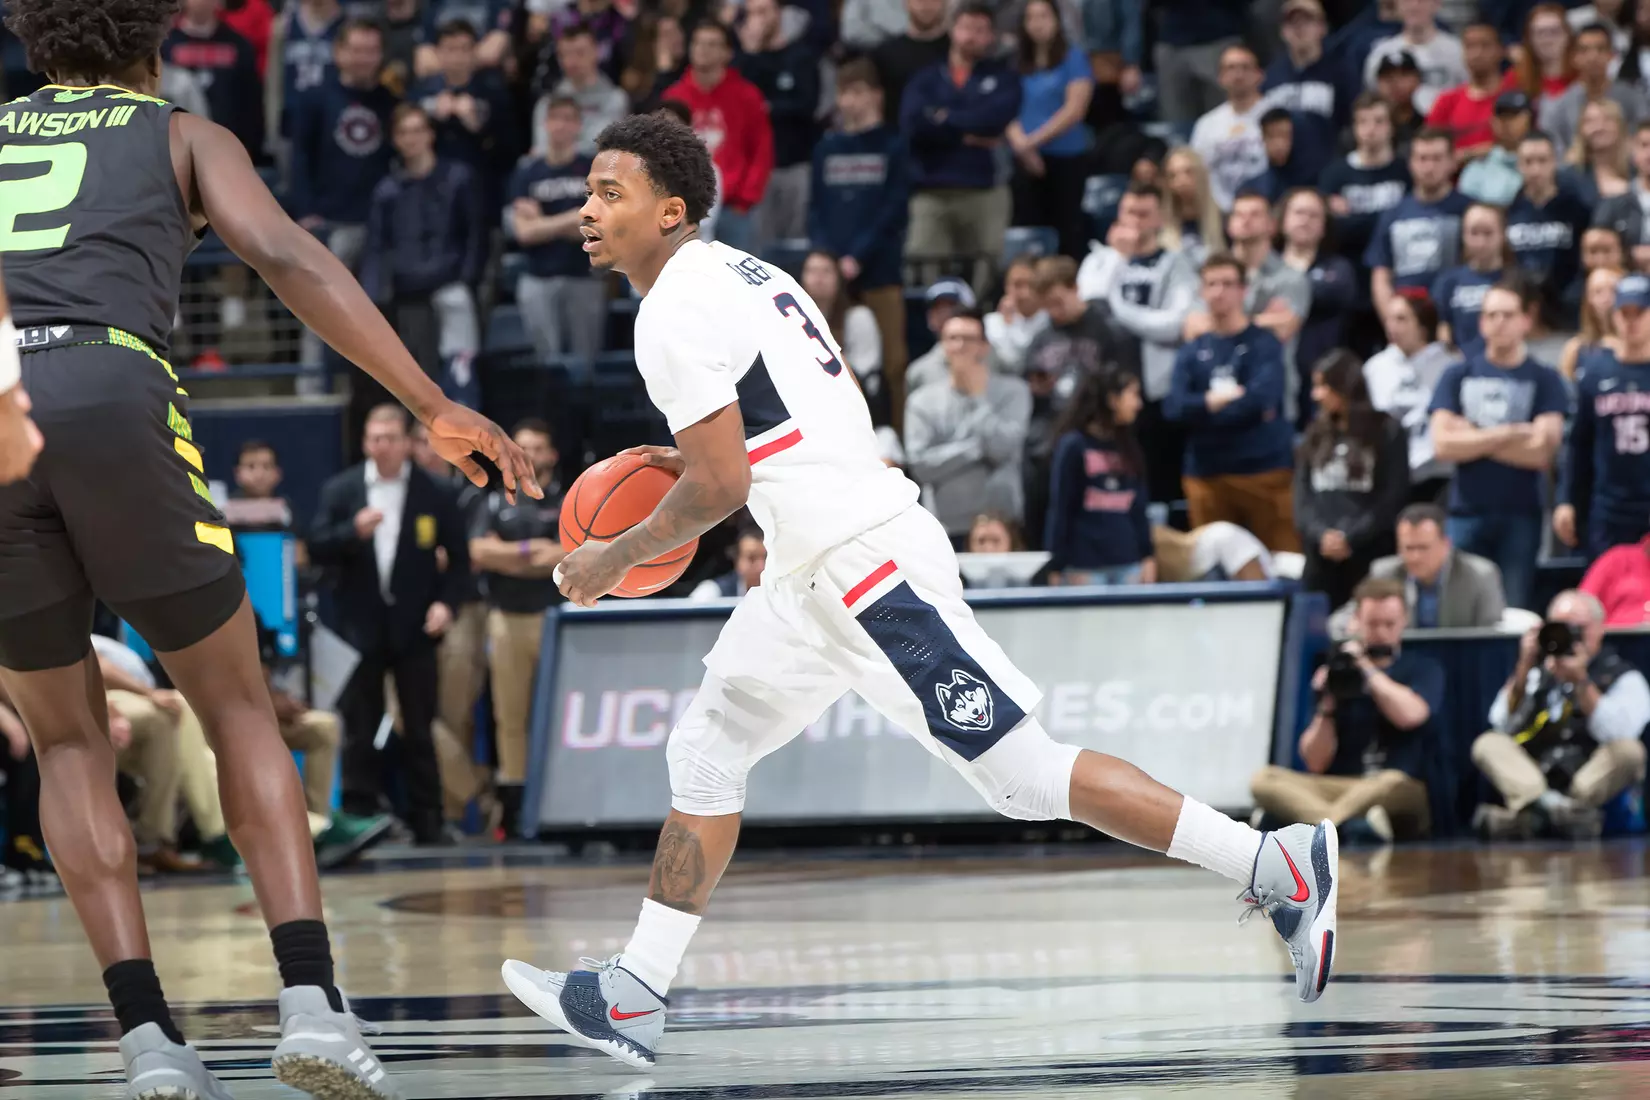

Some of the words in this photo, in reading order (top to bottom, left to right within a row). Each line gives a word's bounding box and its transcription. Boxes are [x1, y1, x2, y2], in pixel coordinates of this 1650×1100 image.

[0, 141, 88, 252] 2
[772, 291, 842, 378] 3
[1612, 414, 1650, 455] 15
